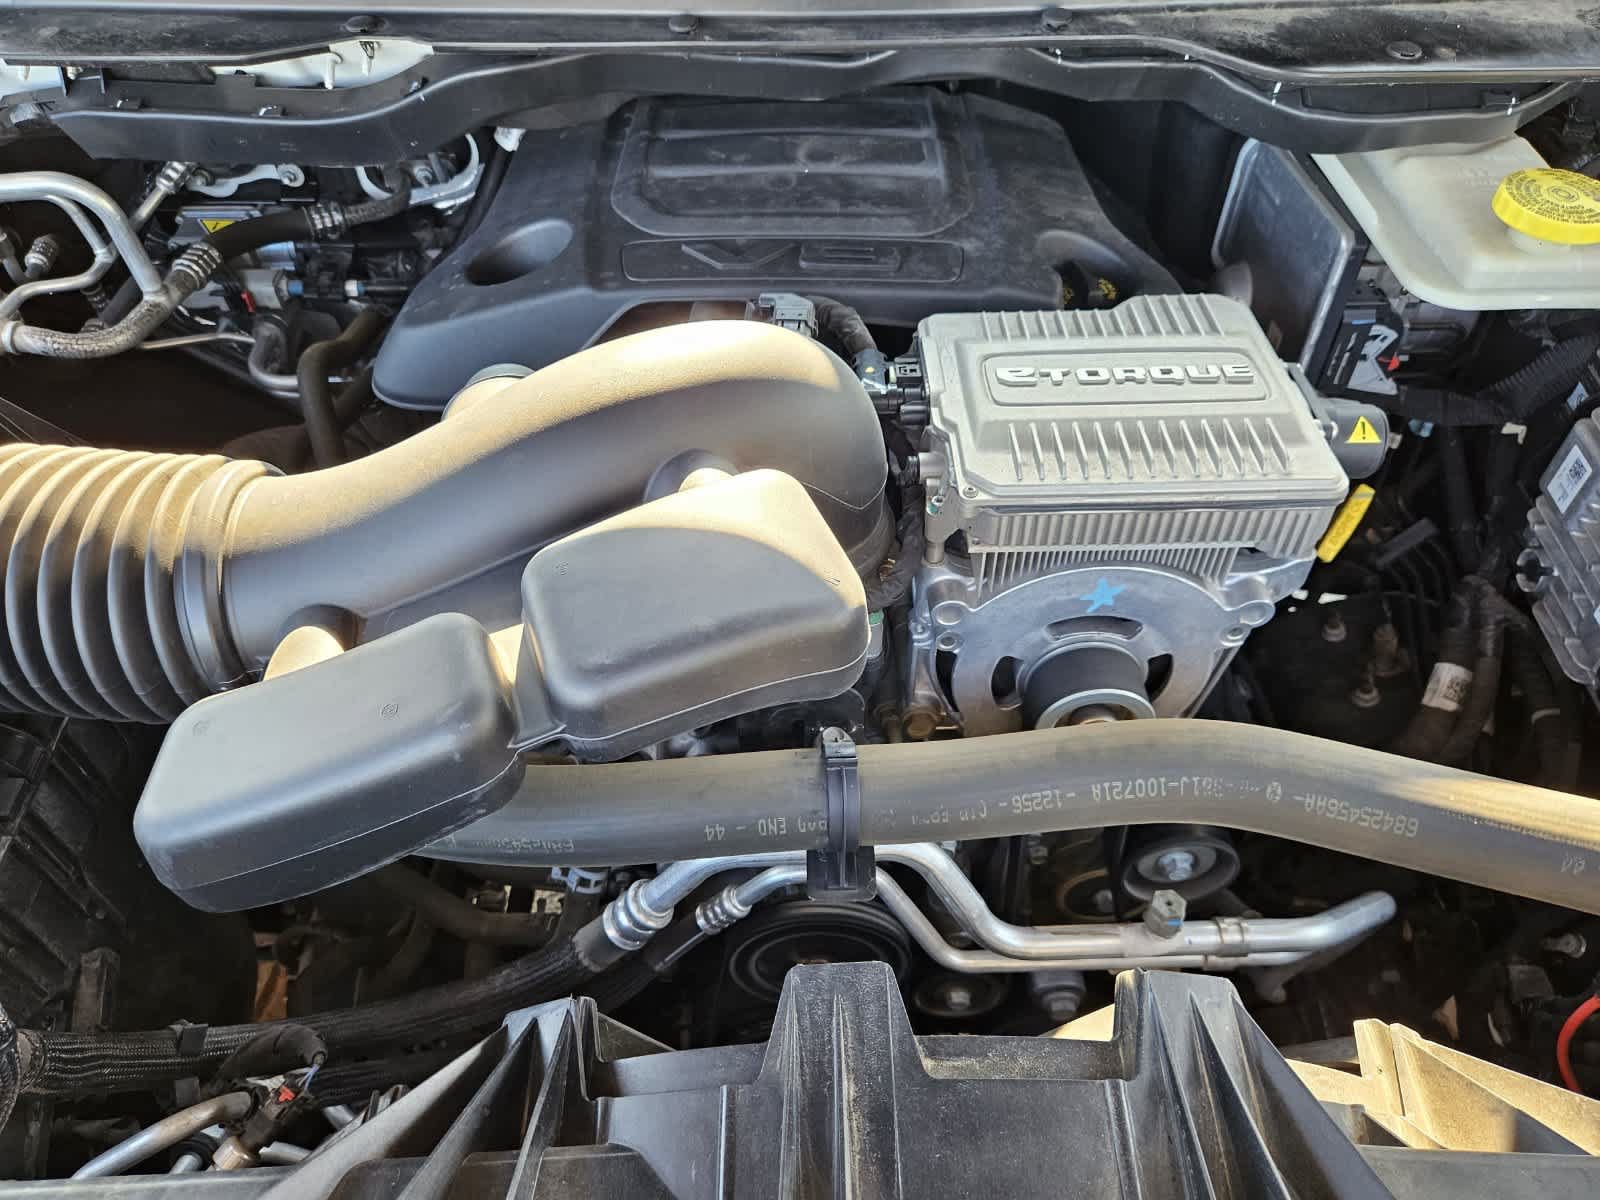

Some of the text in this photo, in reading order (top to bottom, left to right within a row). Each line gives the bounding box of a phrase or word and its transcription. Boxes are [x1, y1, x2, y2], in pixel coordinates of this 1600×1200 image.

[995, 362, 1255, 387] eTORQUE
[703, 822, 726, 842] 44
[757, 816, 788, 837] END
